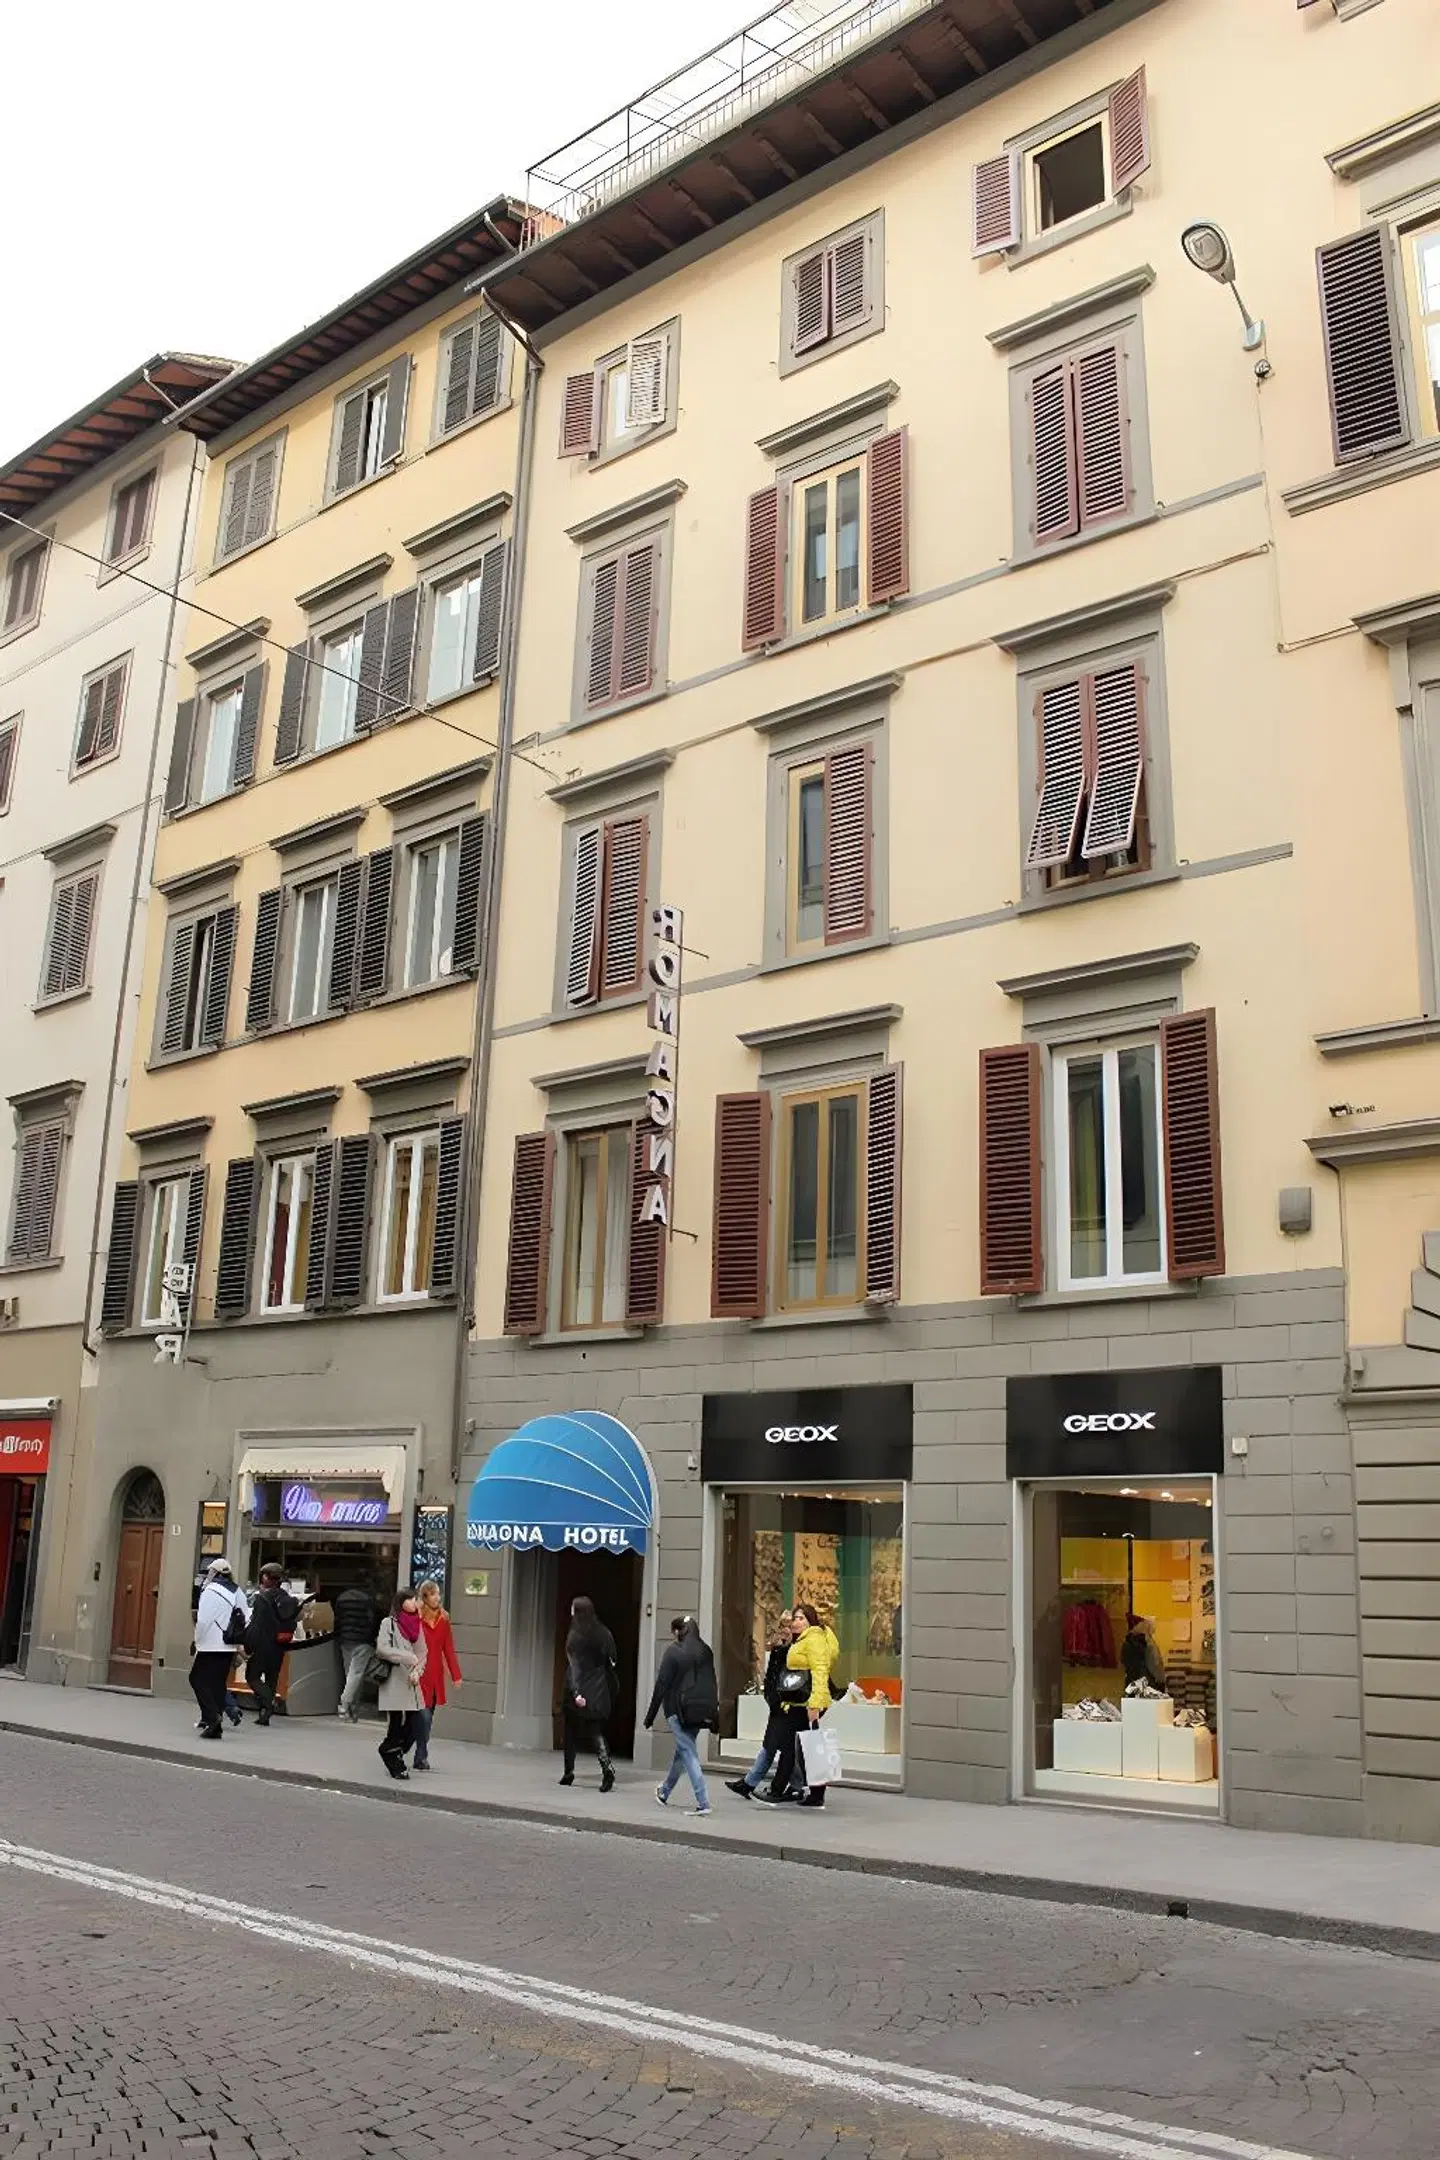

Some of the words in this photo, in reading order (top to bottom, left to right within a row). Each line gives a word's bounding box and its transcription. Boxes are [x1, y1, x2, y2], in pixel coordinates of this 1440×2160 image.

[1063, 1412, 1156, 1432] GEOX
[765, 1425, 839, 1443] GEOX
[564, 1526, 630, 1546] HOTEL
